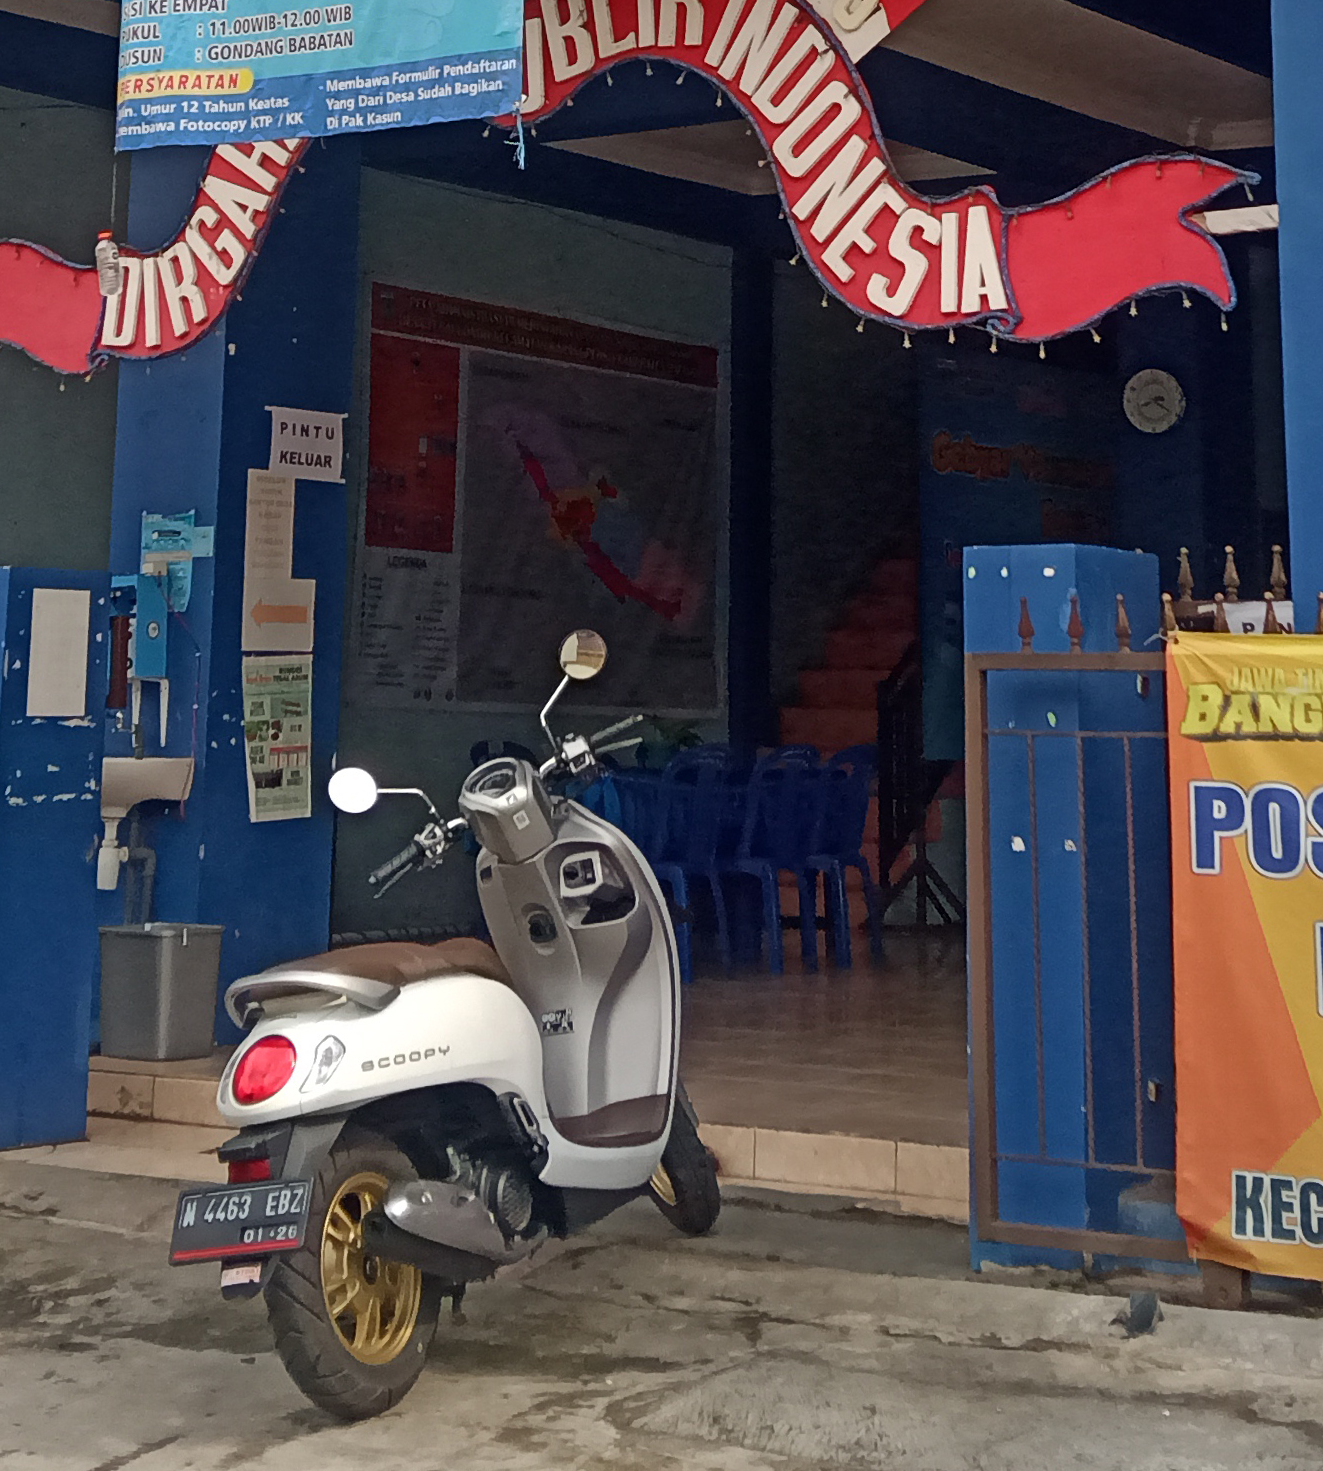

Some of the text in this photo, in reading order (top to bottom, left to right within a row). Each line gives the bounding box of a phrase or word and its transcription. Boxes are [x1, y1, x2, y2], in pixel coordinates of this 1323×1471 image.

[148, 0, 168, 15] KE
[326, 6, 352, 23] WIB
[207, 31, 353, 61] GONDANG BABATAN
[326, 58, 517, 92] Membawa Formulir Pendaftaran
[204, 97, 289, 113] Tahun Keatas
[326, 79, 503, 111] Yang Dari Desa Sudah Bagikan
[119, 115, 273, 136] embawa Fotocopy KTP
[342, 111, 401, 128] Pak Kasun
[279, 421, 335, 441] PINTU
[279, 450, 333, 469] KELUAR
[361, 1045, 450, 1072] SCOOPY
[204, 1195, 251, 1222] 4463
[266, 1187, 303, 1216] EBZ
